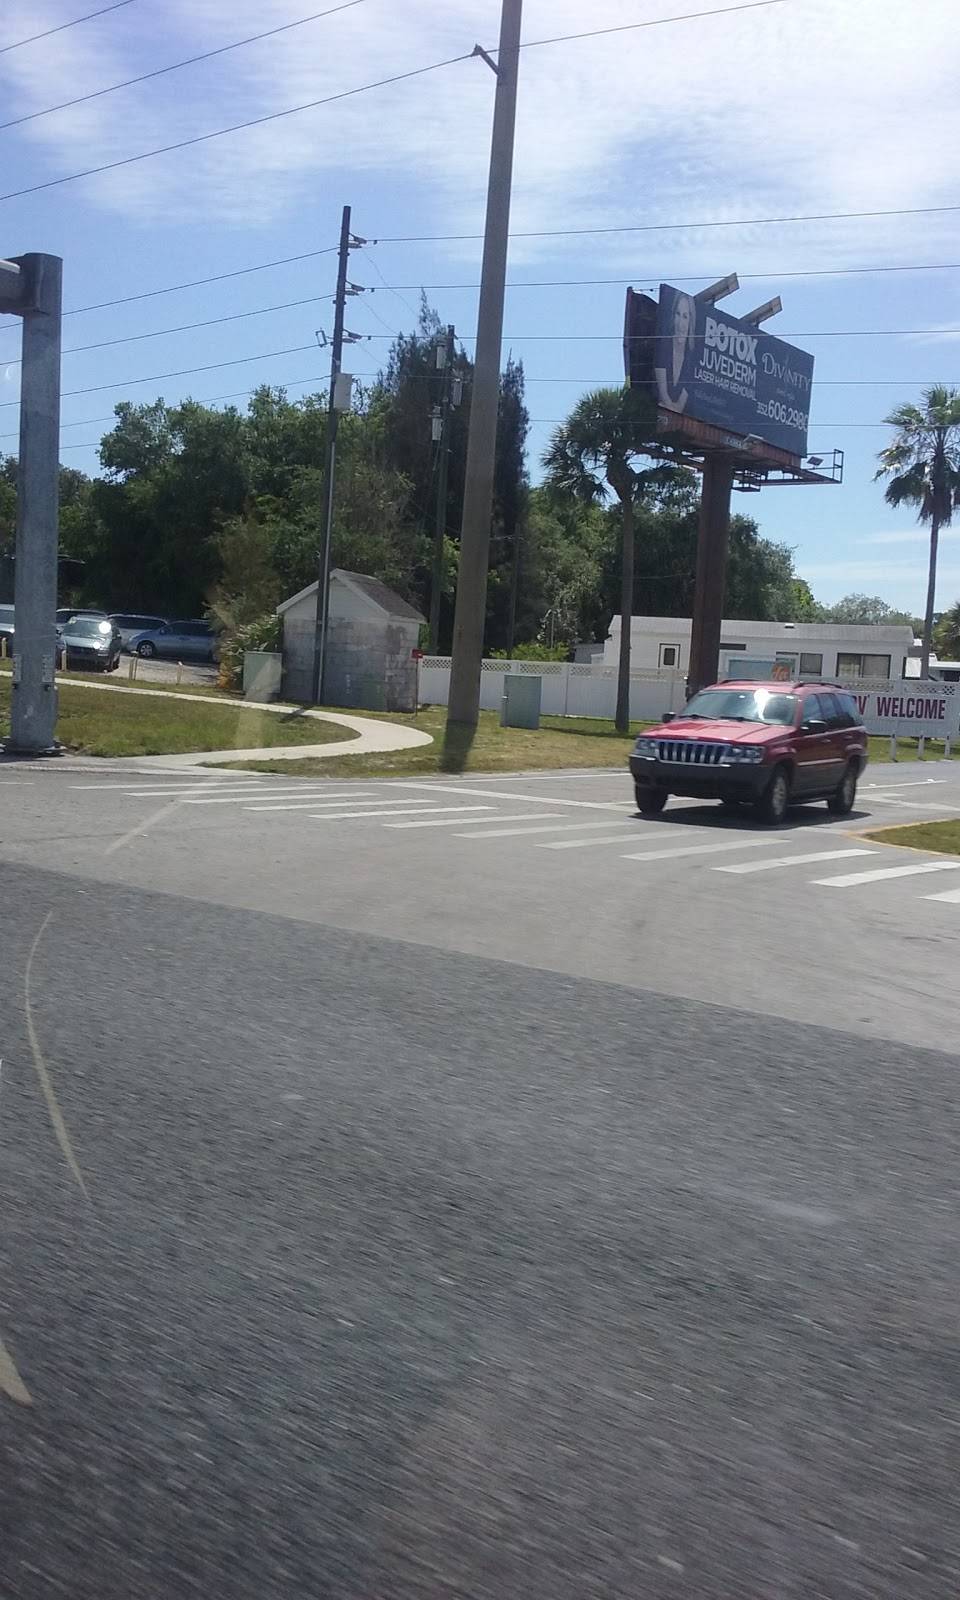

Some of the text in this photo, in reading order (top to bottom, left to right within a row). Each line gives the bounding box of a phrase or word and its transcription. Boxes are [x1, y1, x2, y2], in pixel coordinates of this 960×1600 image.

[705, 316, 758, 365] BOTOX
[694, 367, 714, 384] LASER
[700, 348, 757, 387] JUVEDERM
[877, 696, 946, 720] WELCOME
